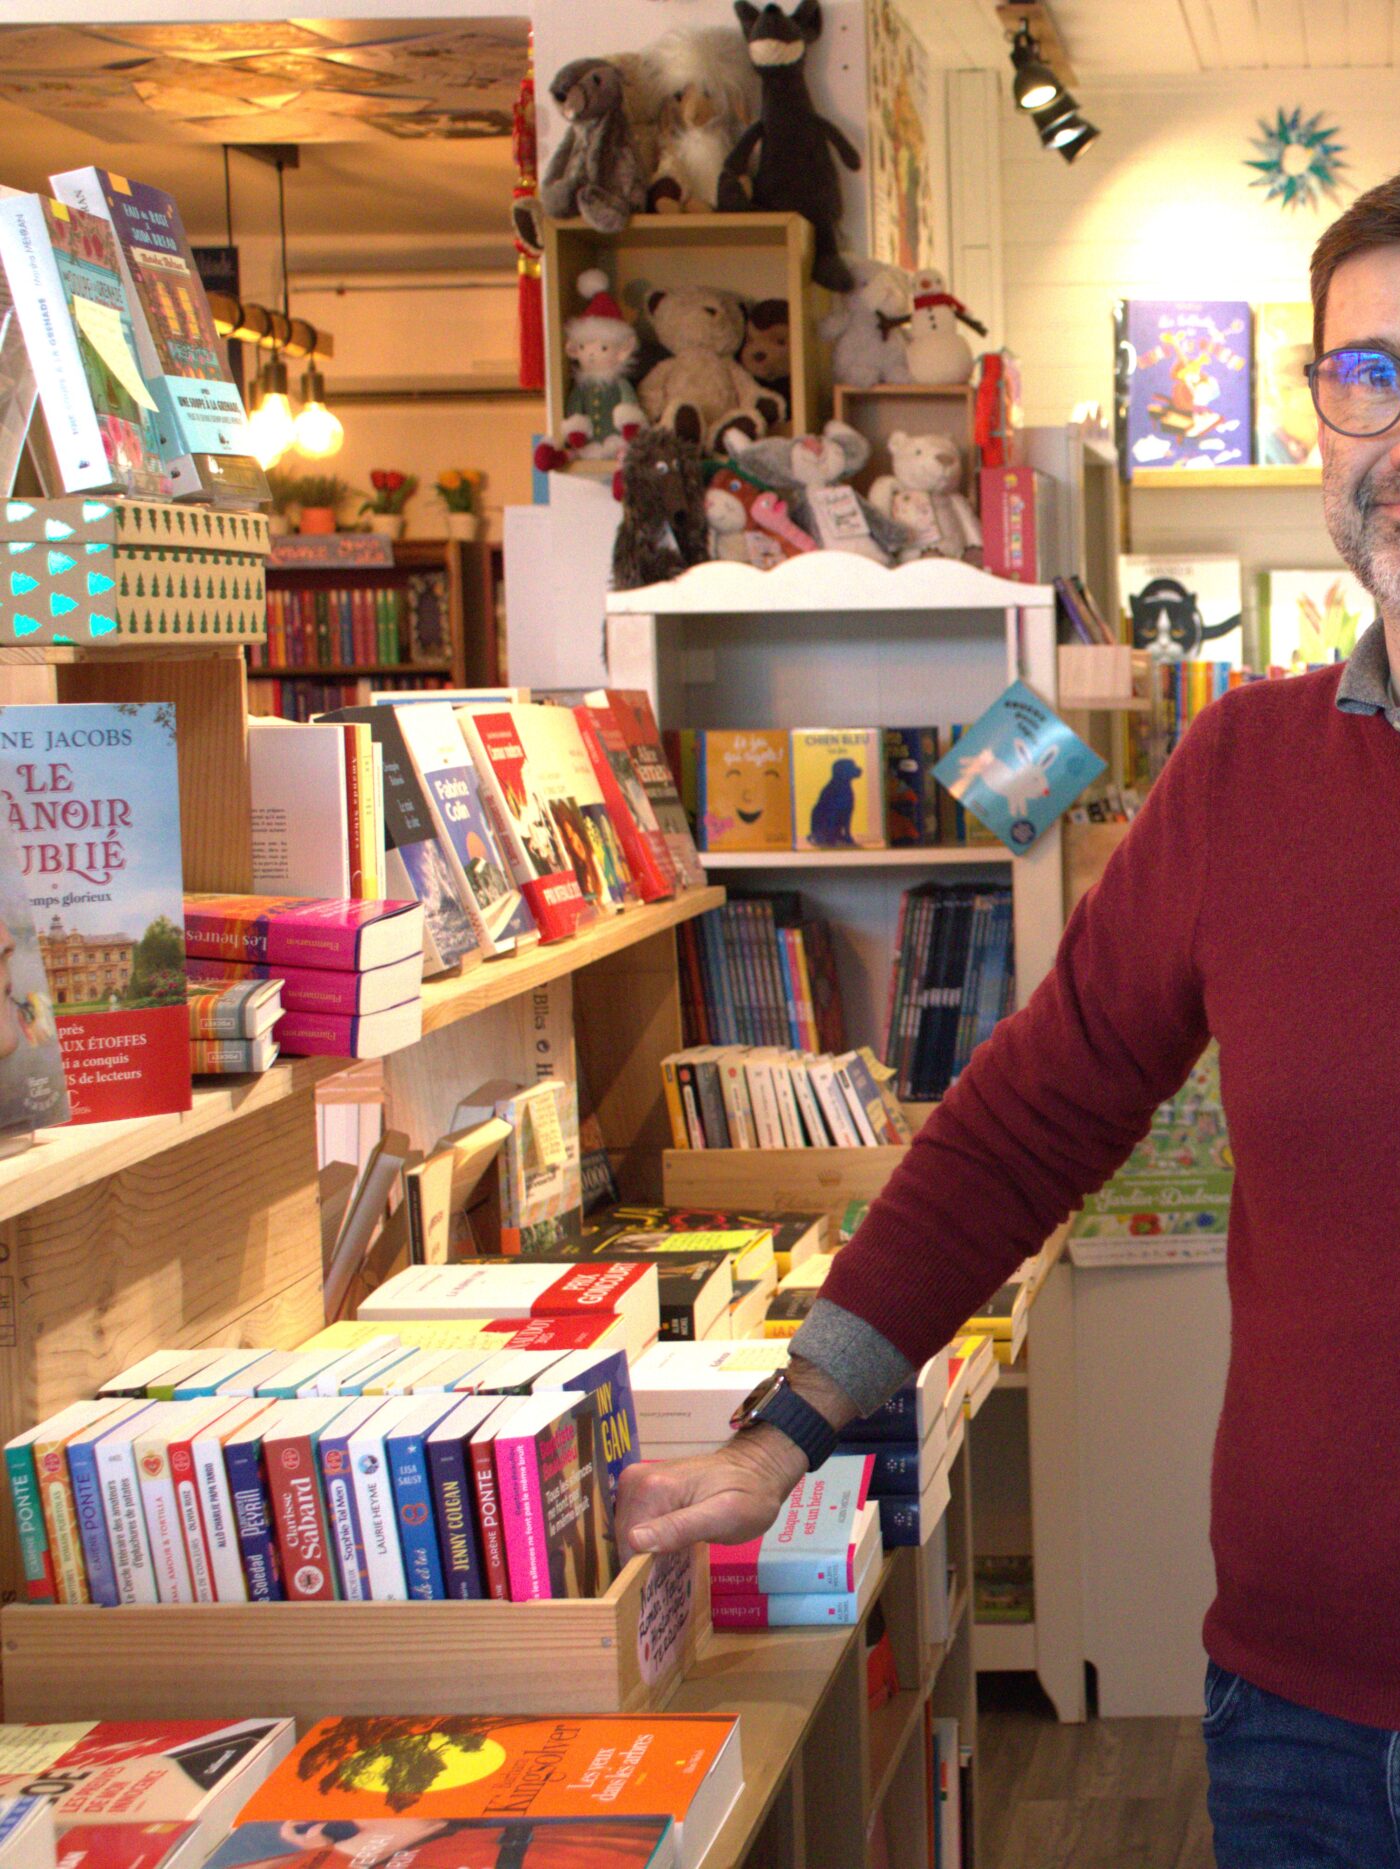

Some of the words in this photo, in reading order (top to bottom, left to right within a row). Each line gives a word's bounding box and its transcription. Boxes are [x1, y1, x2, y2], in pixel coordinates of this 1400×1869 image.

[0, 730, 35, 749] NE
[45, 728, 133, 751] JACOBS
[804, 733, 840, 747] CHIEN
[842, 733, 871, 746] BLEU
[16, 762, 74, 795] LE
[434, 777, 470, 800] Fabrice
[5, 797, 133, 833] ANOIR
[445, 800, 472, 822] Colin
[21, 828, 127, 886] BLIÉ
[62, 891, 113, 908] glorieux
[186, 930, 238, 949] heures
[242, 935, 268, 951] Les
[286, 937, 340, 952] Flammarion
[58, 1024, 85, 1039] près
[88, 1033, 148, 1051] ÉTOFFES
[73, 1060, 80, 1068] a
[83, 1053, 130, 1070] conquis
[79, 1073, 95, 1084] de
[96, 1068, 143, 1083] lecteurs
[562, 1273, 600, 1291] PRIX
[577, 1263, 638, 1304] GONCOURT
[601, 1408, 632, 1463] GAN
[515, 1444, 527, 1466] bruit
[204, 1462, 218, 1485] TANGO
[399, 1463, 418, 1476] LISA
[519, 1466, 529, 1492] même
[106, 1479, 121, 1519] amateurs
[120, 1477, 137, 1507] patates
[181, 1489, 193, 1507] RUIZ
[208, 1485, 220, 1502] PAPA
[334, 1485, 347, 1508] Men
[477, 1469, 498, 1527] PONTE
[559, 1479, 570, 1494] les
[806, 1480, 826, 1508] héros
[13, 1473, 35, 1534] PONTE
[76, 1473, 99, 1532] PONTE
[124, 1508, 134, 1518] de
[235, 1488, 264, 1537] PEYRIN
[367, 1482, 382, 1519] HEYME
[442, 1480, 464, 1529] COLGAN
[523, 1502, 533, 1516] pas
[110, 1519, 122, 1532] des
[156, 1496, 170, 1537] TORTILLA
[184, 1506, 197, 1532] OLIVIA
[211, 1502, 225, 1531] CHARLIE
[281, 1492, 301, 1548] Clarisse
[290, 1476, 321, 1560] Sabard
[338, 1508, 349, 1522] Tal
[523, 1517, 534, 1535] font
[778, 1509, 799, 1544] Chaque
[807, 1508, 820, 1521] un
[214, 1531, 227, 1548] ALLÔ
[373, 1520, 387, 1555] LAURIE
[804, 1521, 817, 1536] est
[114, 1533, 131, 1567] littéraire
[127, 1518, 145, 1568] d'épluchures
[342, 1523, 356, 1562] Sophie
[447, 1532, 470, 1571] JENNY
[487, 1530, 501, 1568] CARÈNE
[163, 1548, 176, 1579] AMOUR
[191, 1537, 206, 1577] COULEURS
[527, 1547, 539, 1580] silences
[64, 1569, 82, 1603] ONFITURES
[121, 1567, 135, 1593] Cercle
[248, 1553, 268, 1595] Soledad
[530, 1580, 540, 1593] les
[720, 1606, 747, 1617] chien
[748, 1606, 761, 1617] Le
[482, 1723, 582, 1817] Kingsolver
[566, 1769, 599, 1791] Les
[591, 1746, 616, 1773] yeux
[591, 1774, 624, 1802] dans
[619, 1733, 655, 1767] arbres
